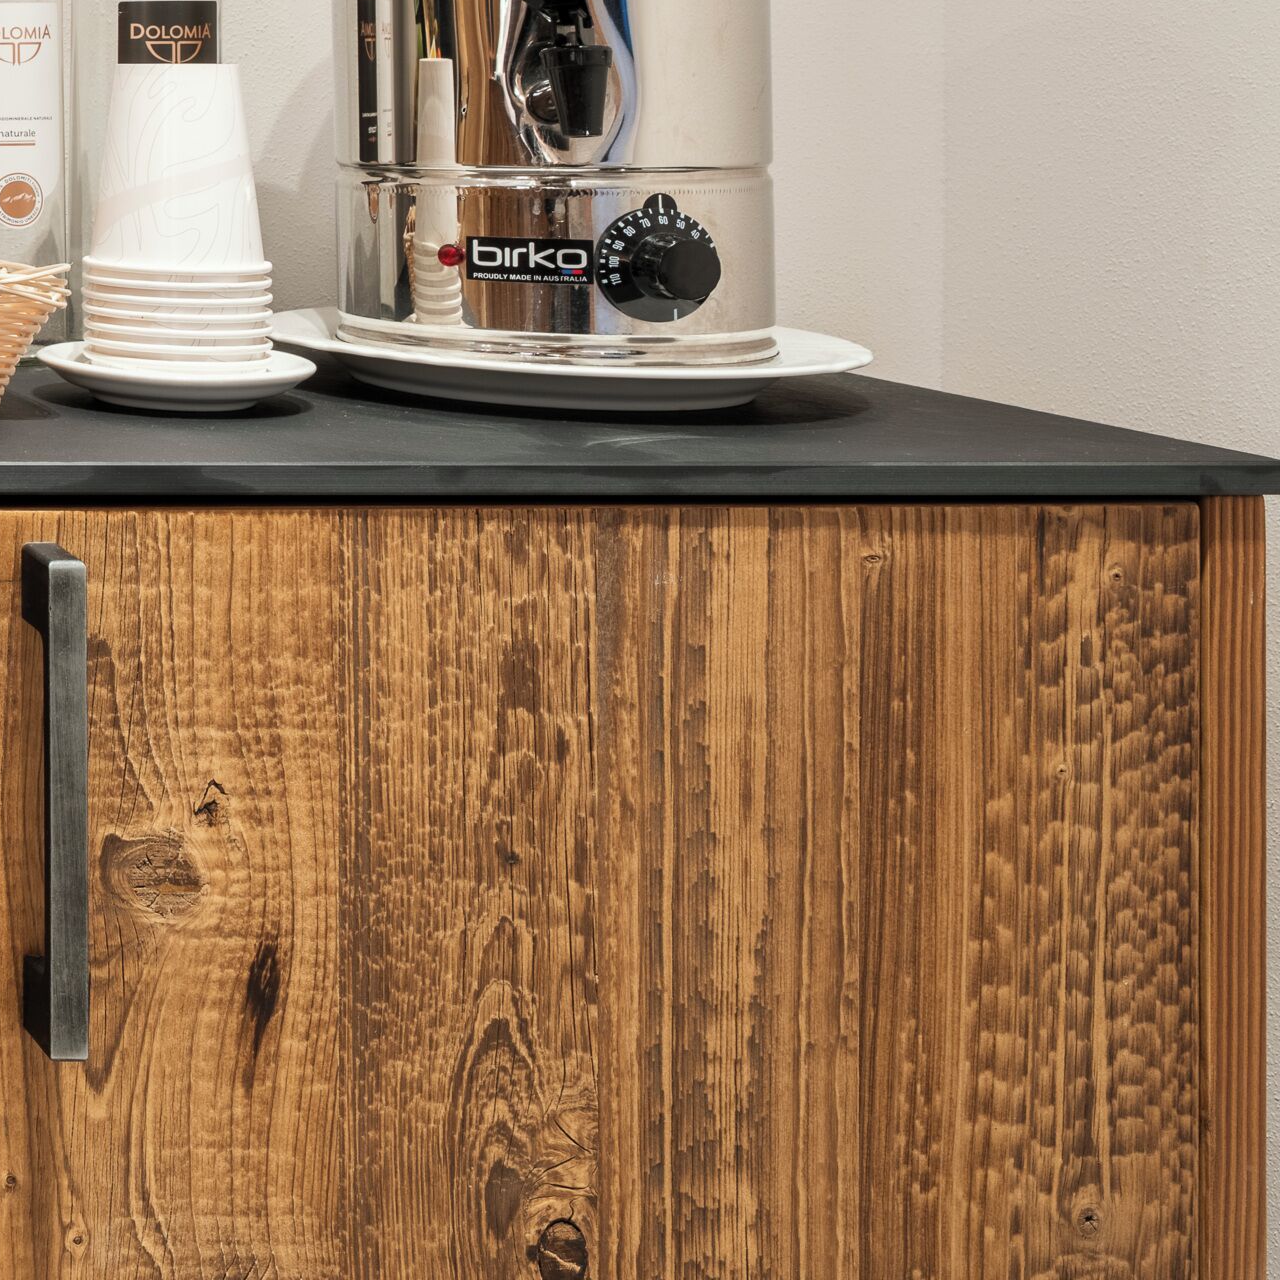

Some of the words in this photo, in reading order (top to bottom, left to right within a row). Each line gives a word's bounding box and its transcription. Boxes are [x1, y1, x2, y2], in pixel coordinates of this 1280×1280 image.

[129, 23, 211, 40] DOLOMIA
[639, 218, 651, 229] 70
[658, 215, 668, 225] 60
[676, 220, 686, 230] 50
[623, 225, 636, 237] 80
[690, 229, 701, 240] 40
[612, 239, 625, 251] 90
[472, 239, 588, 269] birko
[608, 255, 620, 268] 100
[473, 272, 508, 280] PROUDLY
[609, 273, 622, 285] 110
